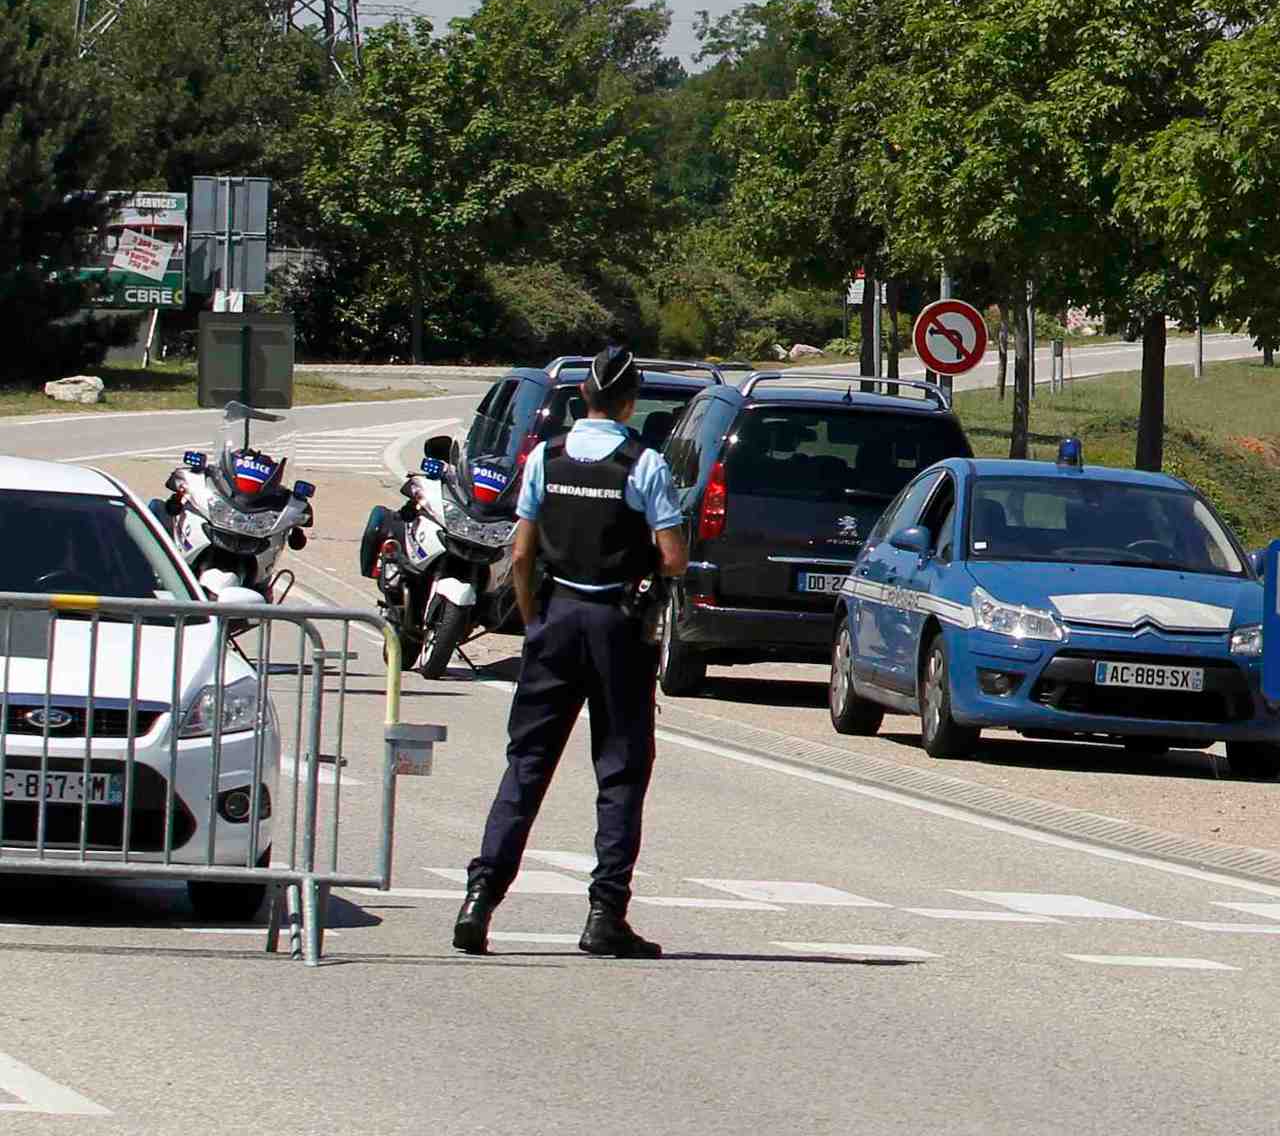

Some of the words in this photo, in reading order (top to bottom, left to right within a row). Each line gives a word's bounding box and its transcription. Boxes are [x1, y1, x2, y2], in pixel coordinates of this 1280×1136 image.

[124, 289, 174, 304] CBRE
[236, 458, 271, 475] POLICE
[473, 467, 508, 485] POLICE
[546, 483, 623, 500] GENDARMERIE
[1109, 665, 1191, 689] AC-889-SX
